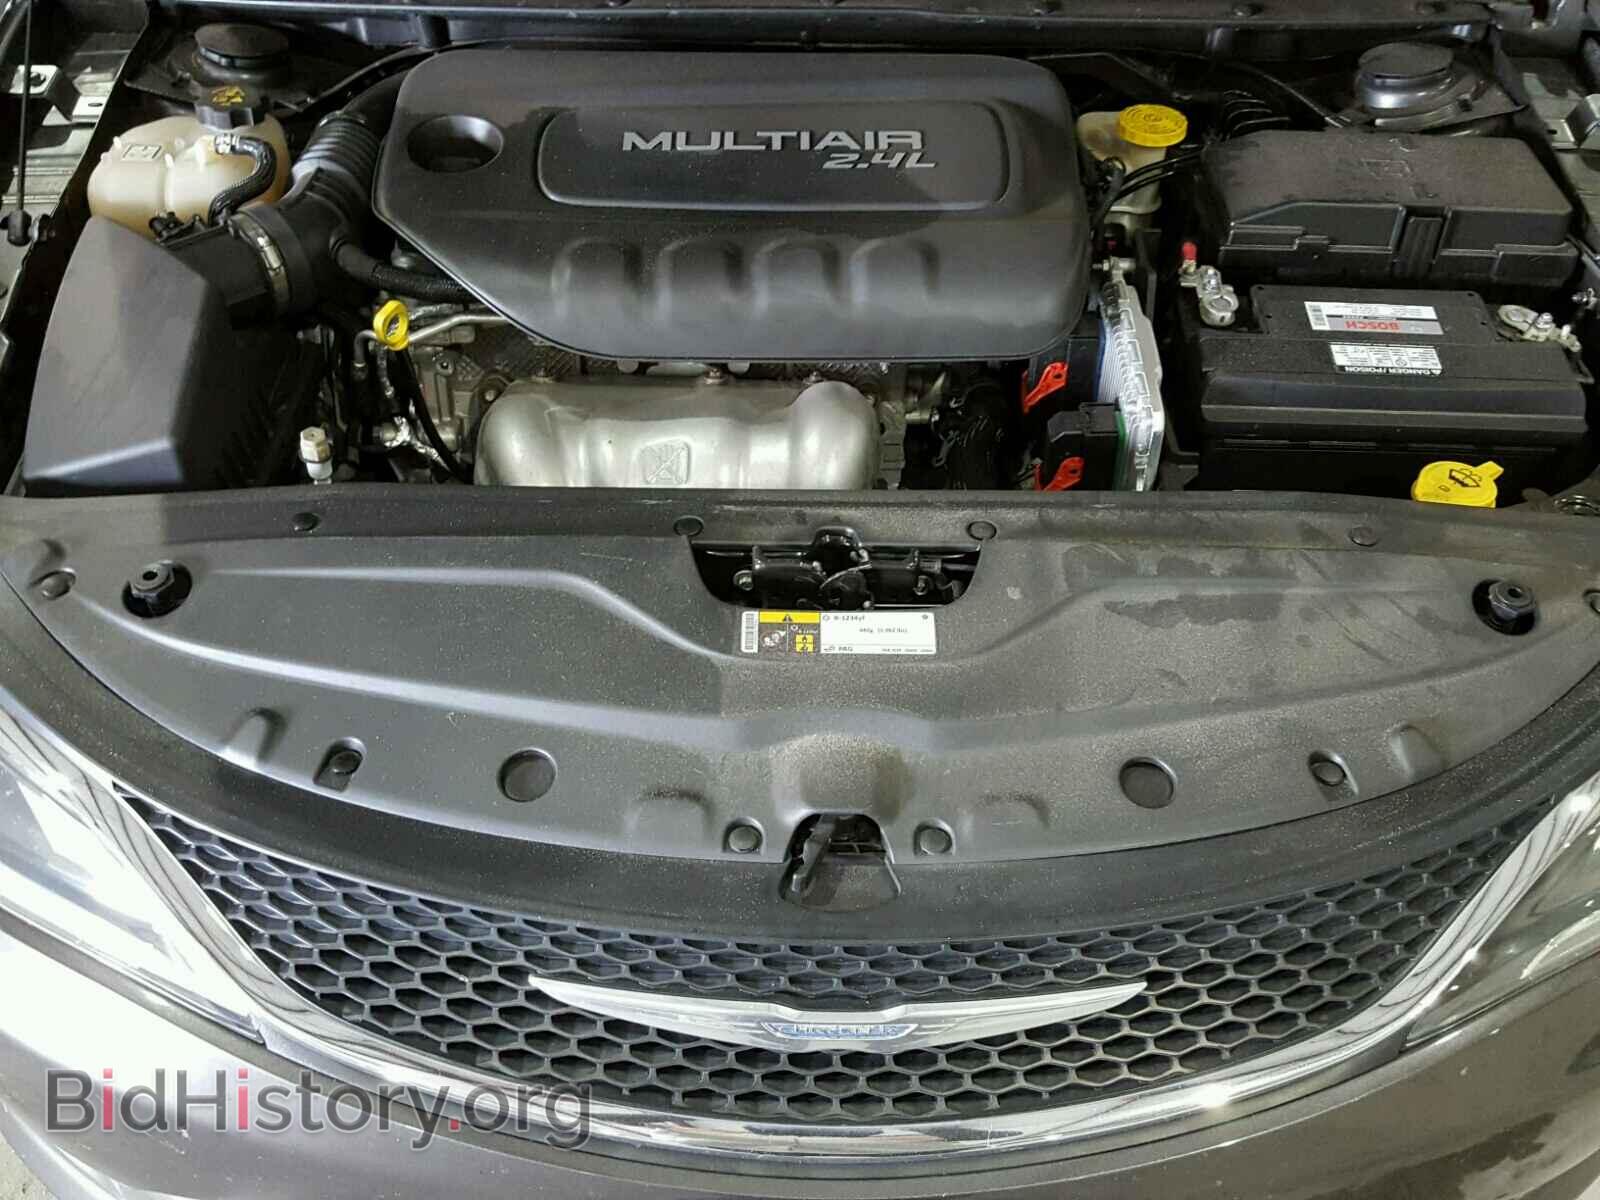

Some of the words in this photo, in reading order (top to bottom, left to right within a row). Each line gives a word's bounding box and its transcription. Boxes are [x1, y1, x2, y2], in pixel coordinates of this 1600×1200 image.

[622, 130, 923, 152] MULTIAIR
[822, 152, 937, 170] 2.4L
[1344, 320, 1401, 332] BOSCH
[1389, 367, 1431, 376] DANGER
